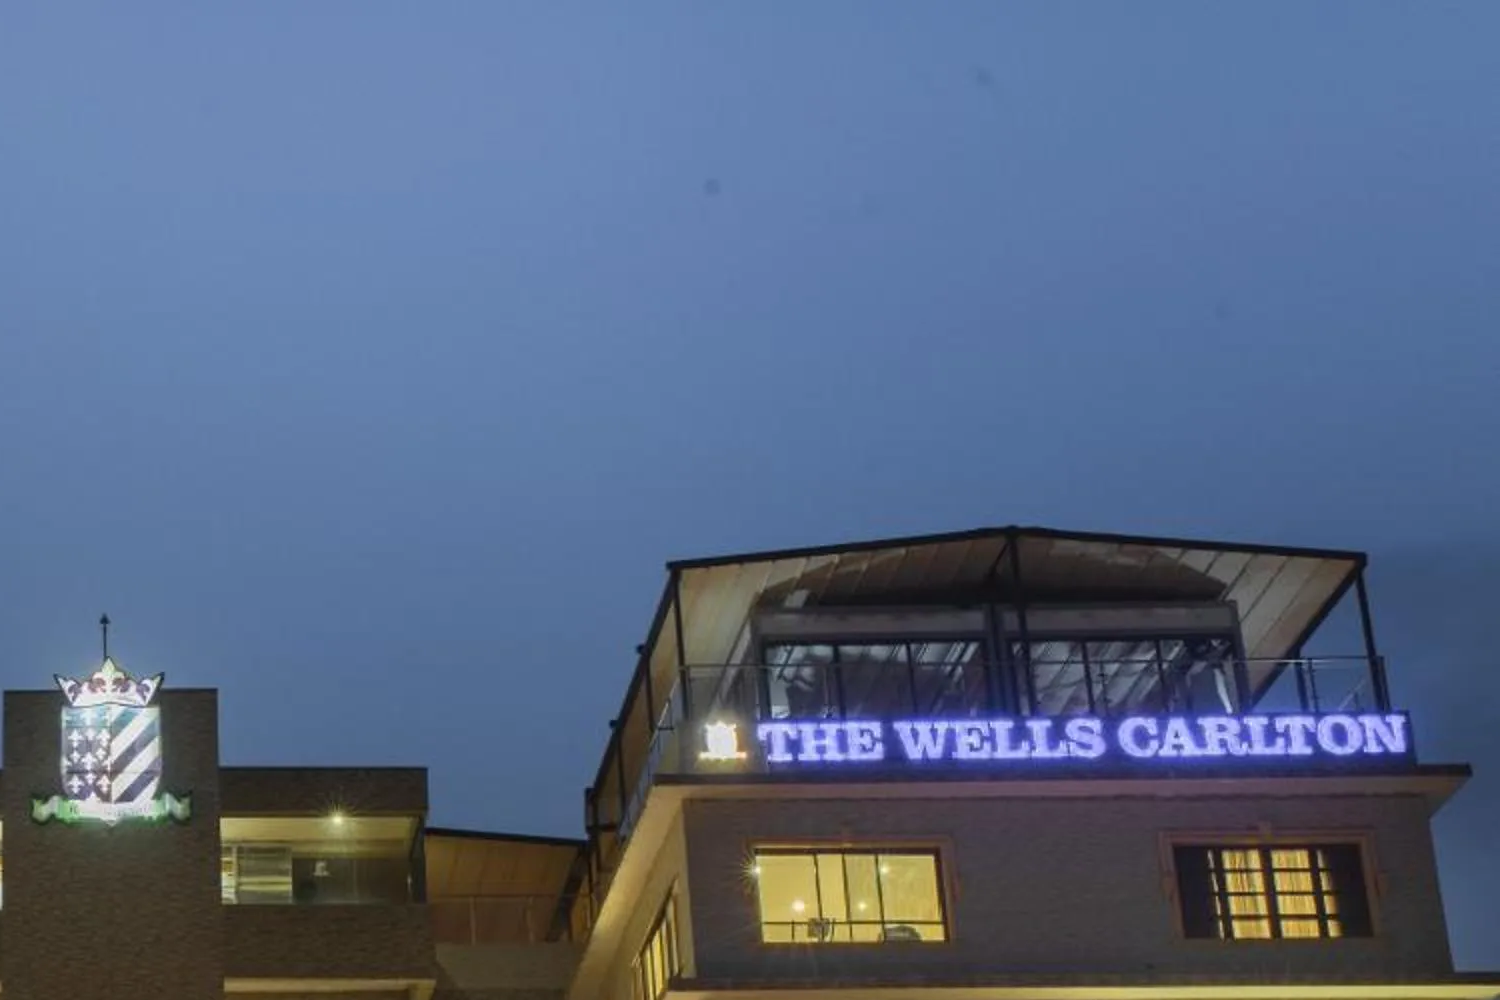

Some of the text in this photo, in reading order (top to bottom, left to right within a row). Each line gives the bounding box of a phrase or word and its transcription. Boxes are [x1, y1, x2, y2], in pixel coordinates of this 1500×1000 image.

[758, 713, 1407, 762] THE WELLS CARLTON
